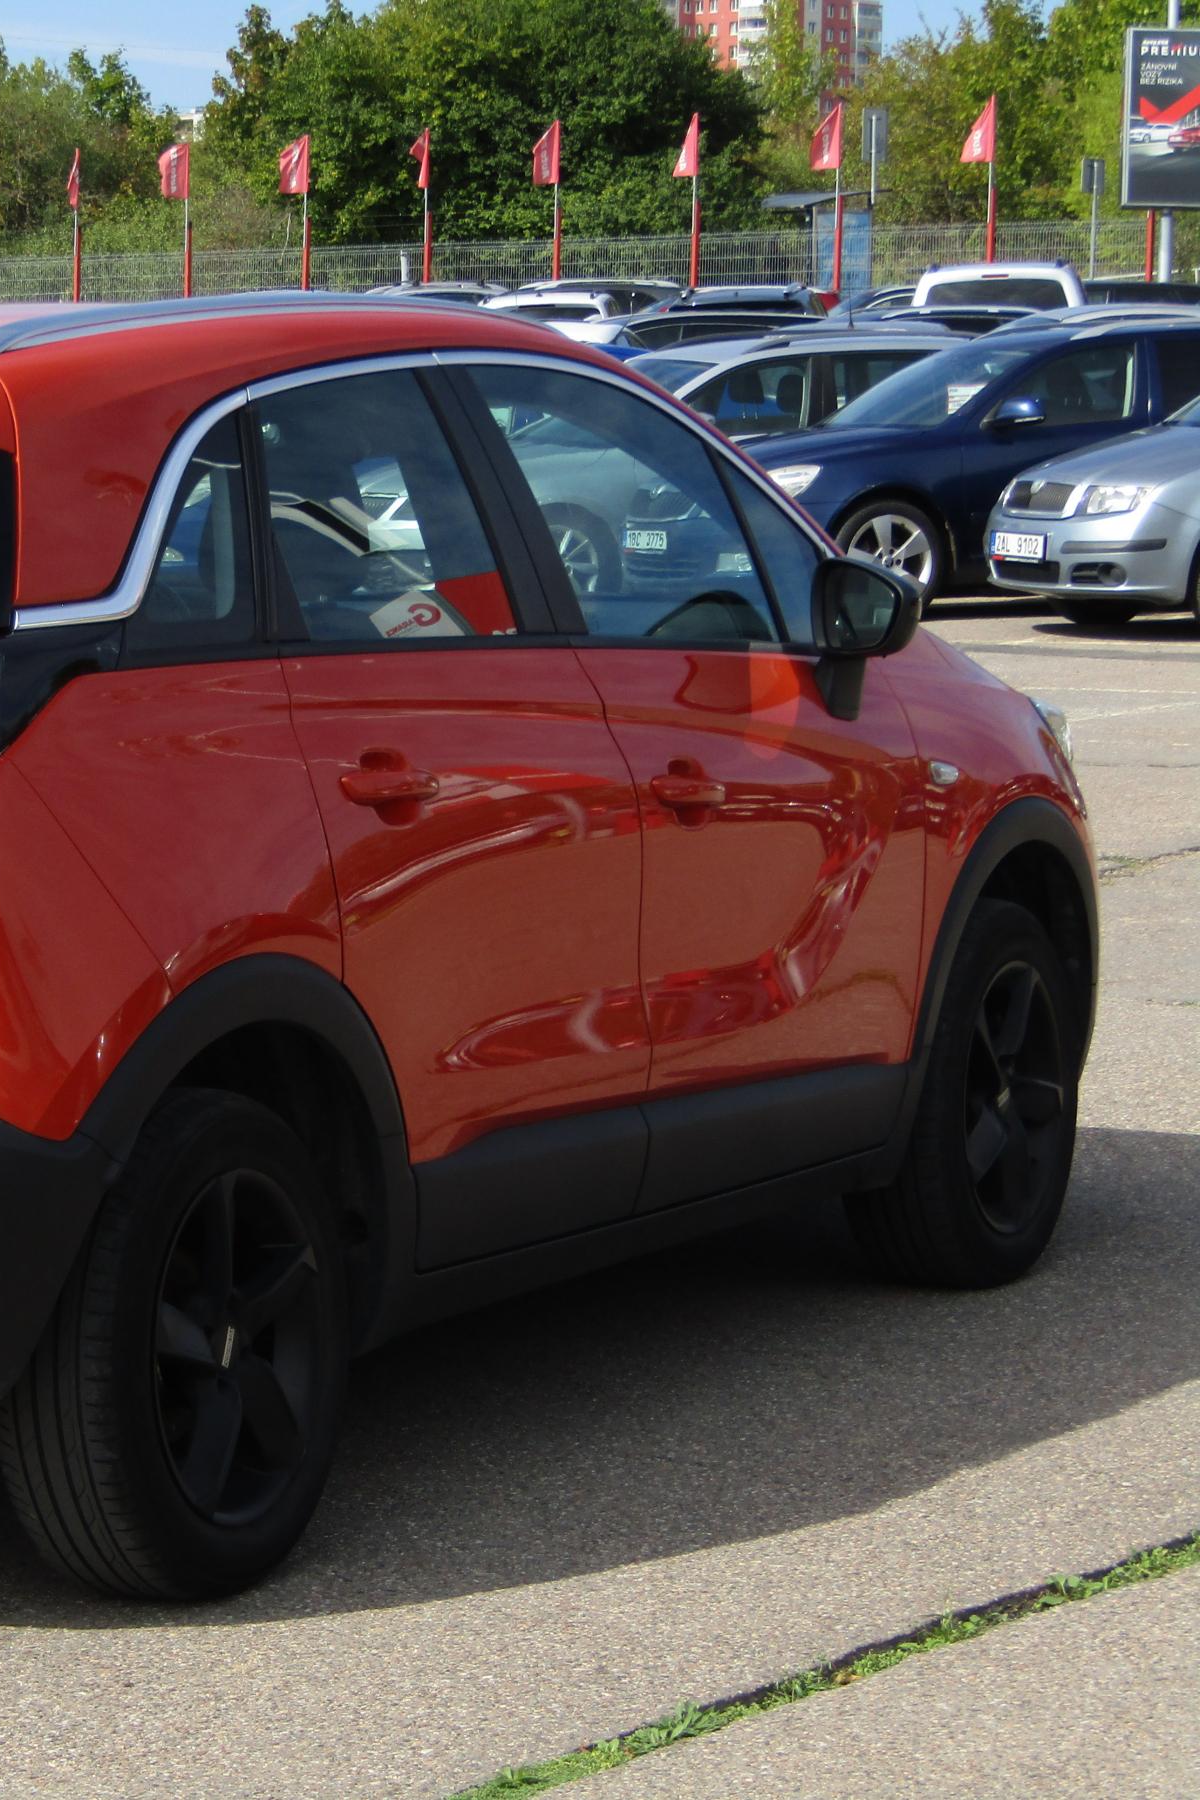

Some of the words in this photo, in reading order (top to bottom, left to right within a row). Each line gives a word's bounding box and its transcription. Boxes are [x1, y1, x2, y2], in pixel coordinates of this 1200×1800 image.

[1140, 45, 1200, 56] PREMIU
[996, 535, 1010, 553] 2AL
[1017, 537, 1039, 555] 9102
